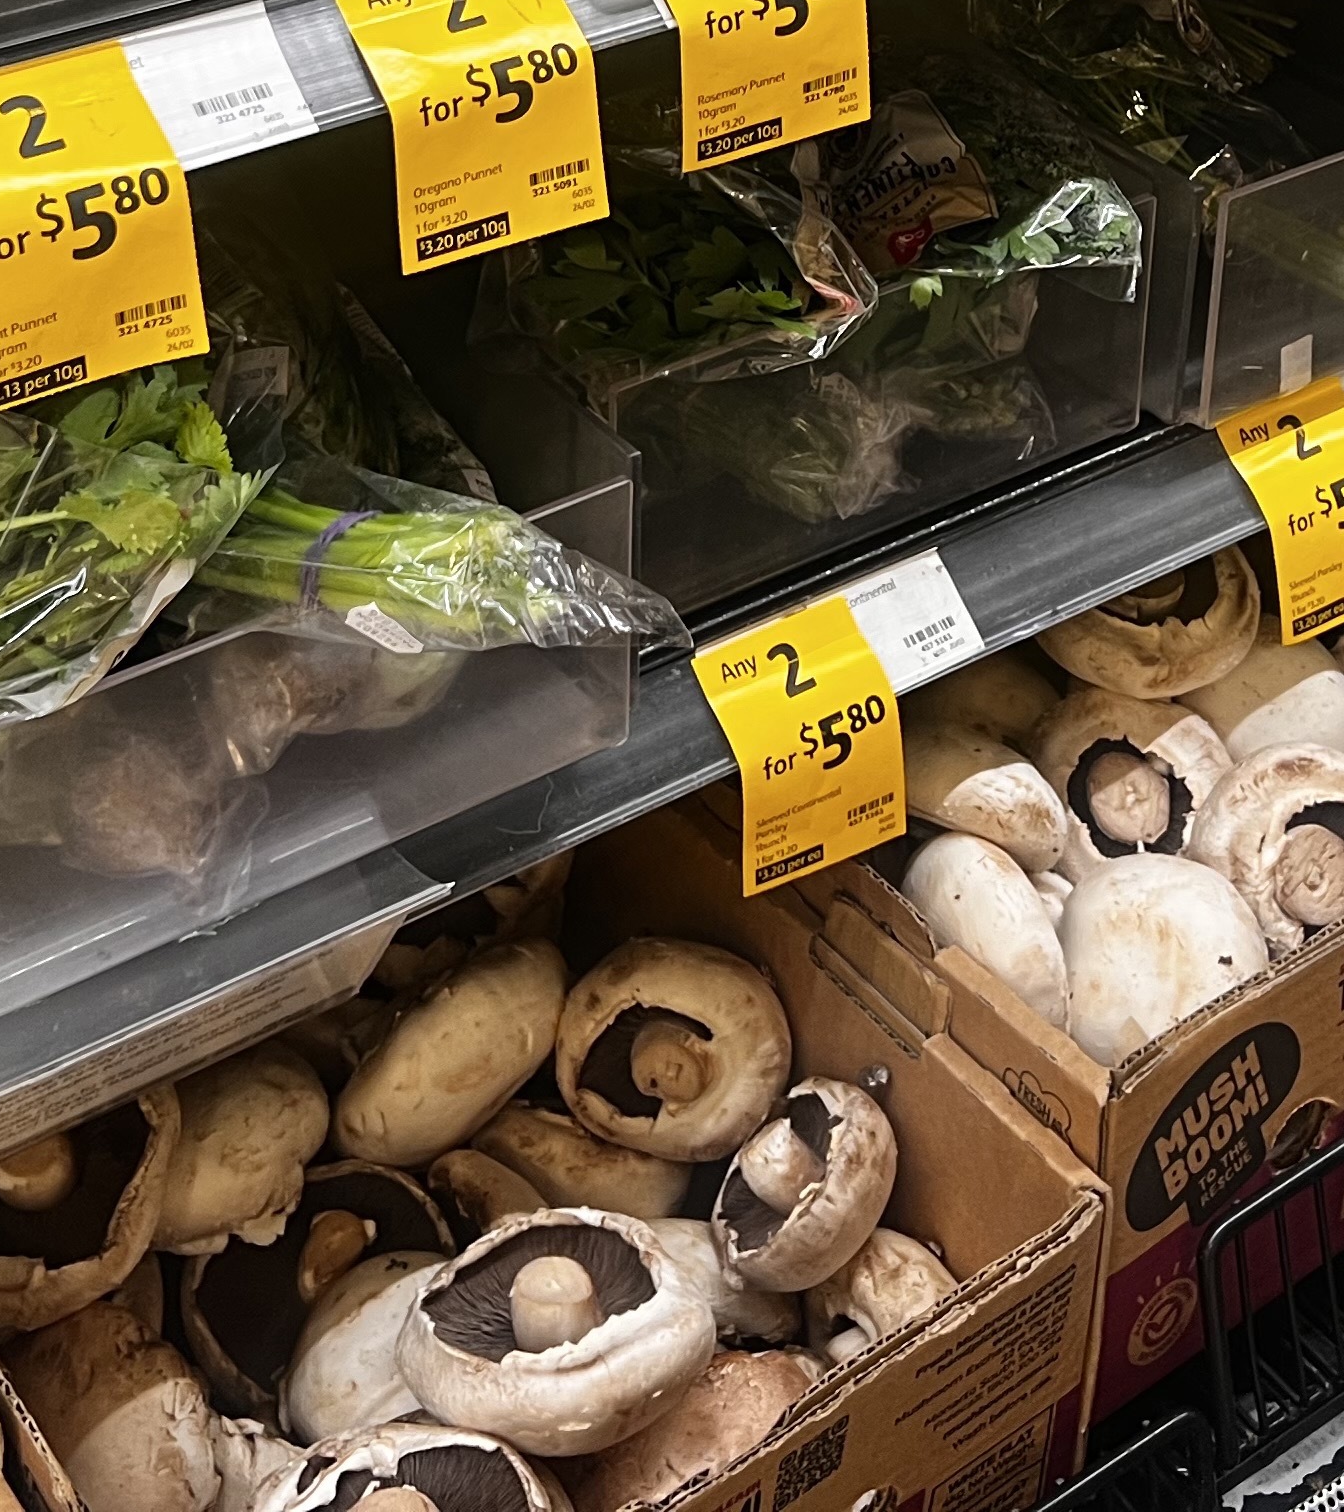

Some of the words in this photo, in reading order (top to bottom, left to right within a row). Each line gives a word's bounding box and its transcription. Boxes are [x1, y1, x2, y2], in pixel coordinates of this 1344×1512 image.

[705, 9, 745, 39] for
[698, 82, 748, 106] Rosemary
[749, 71, 785, 91] Punnet
[419, 95, 464, 127] for
[414, 176, 462, 200] Oregano
[464, 163, 503, 185] Punnet
[11, 311, 58, 338] Punnet
[1239, 422, 1269, 446] Any
[1276, 414, 1322, 460] 2
[1288, 509, 1315, 536] for
[721, 654, 757, 683] Any
[767, 643, 817, 698] 2
[763, 751, 797, 780] for
[1154, 1040, 1262, 1171] MUSH
[1162, 1071, 1270, 1202] BOOM!
[1198, 1166, 1218, 1190] TO
[1221, 1137, 1248, 1169] THE
[1198, 1152, 1254, 1208] RESCUE
